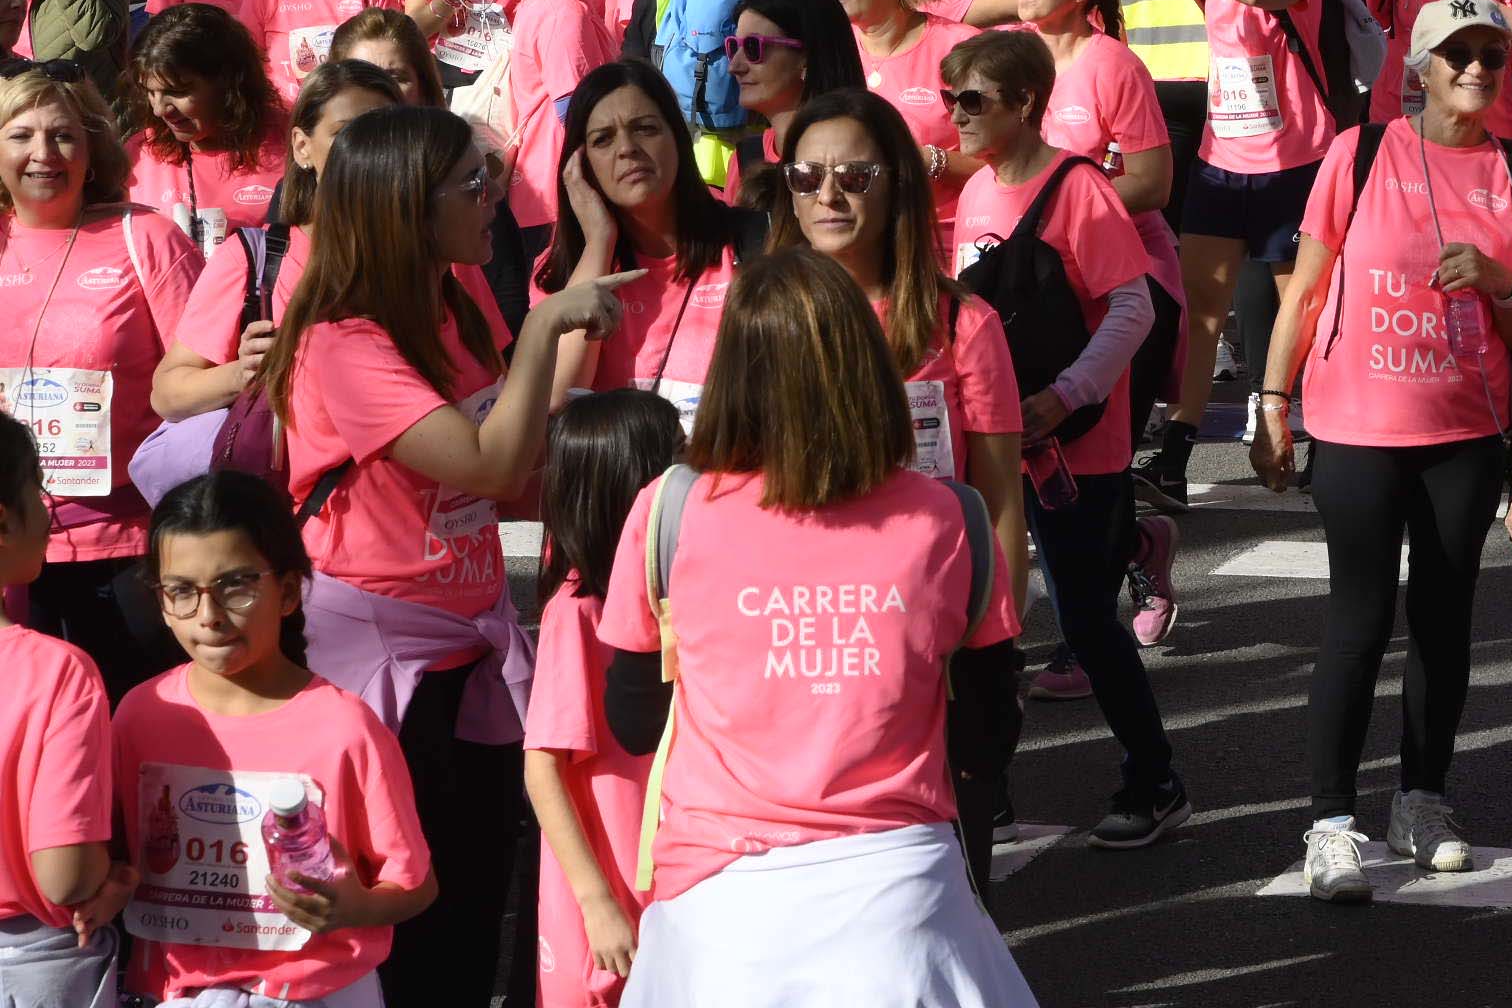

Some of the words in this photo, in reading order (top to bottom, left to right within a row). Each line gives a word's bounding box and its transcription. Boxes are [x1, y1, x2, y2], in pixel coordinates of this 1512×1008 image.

[1223, 89, 1247, 100] 016
[1369, 269, 1407, 297] TU
[1369, 344, 1458, 374] SUMA
[1368, 374, 1398, 383] CARRERA
[1400, 375, 1408, 383] DE
[1418, 376, 1441, 384] MUJER
[74, 386, 102, 394] SUMA
[48, 459, 75, 467] MUJER
[78, 459, 97, 467] 2023
[57, 476, 101, 486] Santander
[737, 584, 906, 615] CARRERA
[771, 617, 816, 647] DE
[833, 615, 874, 645] LA
[764, 648, 881, 678] MUJER
[810, 682, 841, 694] 2023
[184, 798, 256, 818] ASTURIANA
[186, 836, 249, 865] 016
[189, 870, 240, 889] 21240
[192, 894, 206, 905] DE
[209, 896, 223, 906] LA
[227, 897, 264, 910] MUJER
[140, 914, 189, 930] OYSHO
[235, 920, 297, 937] Santander
